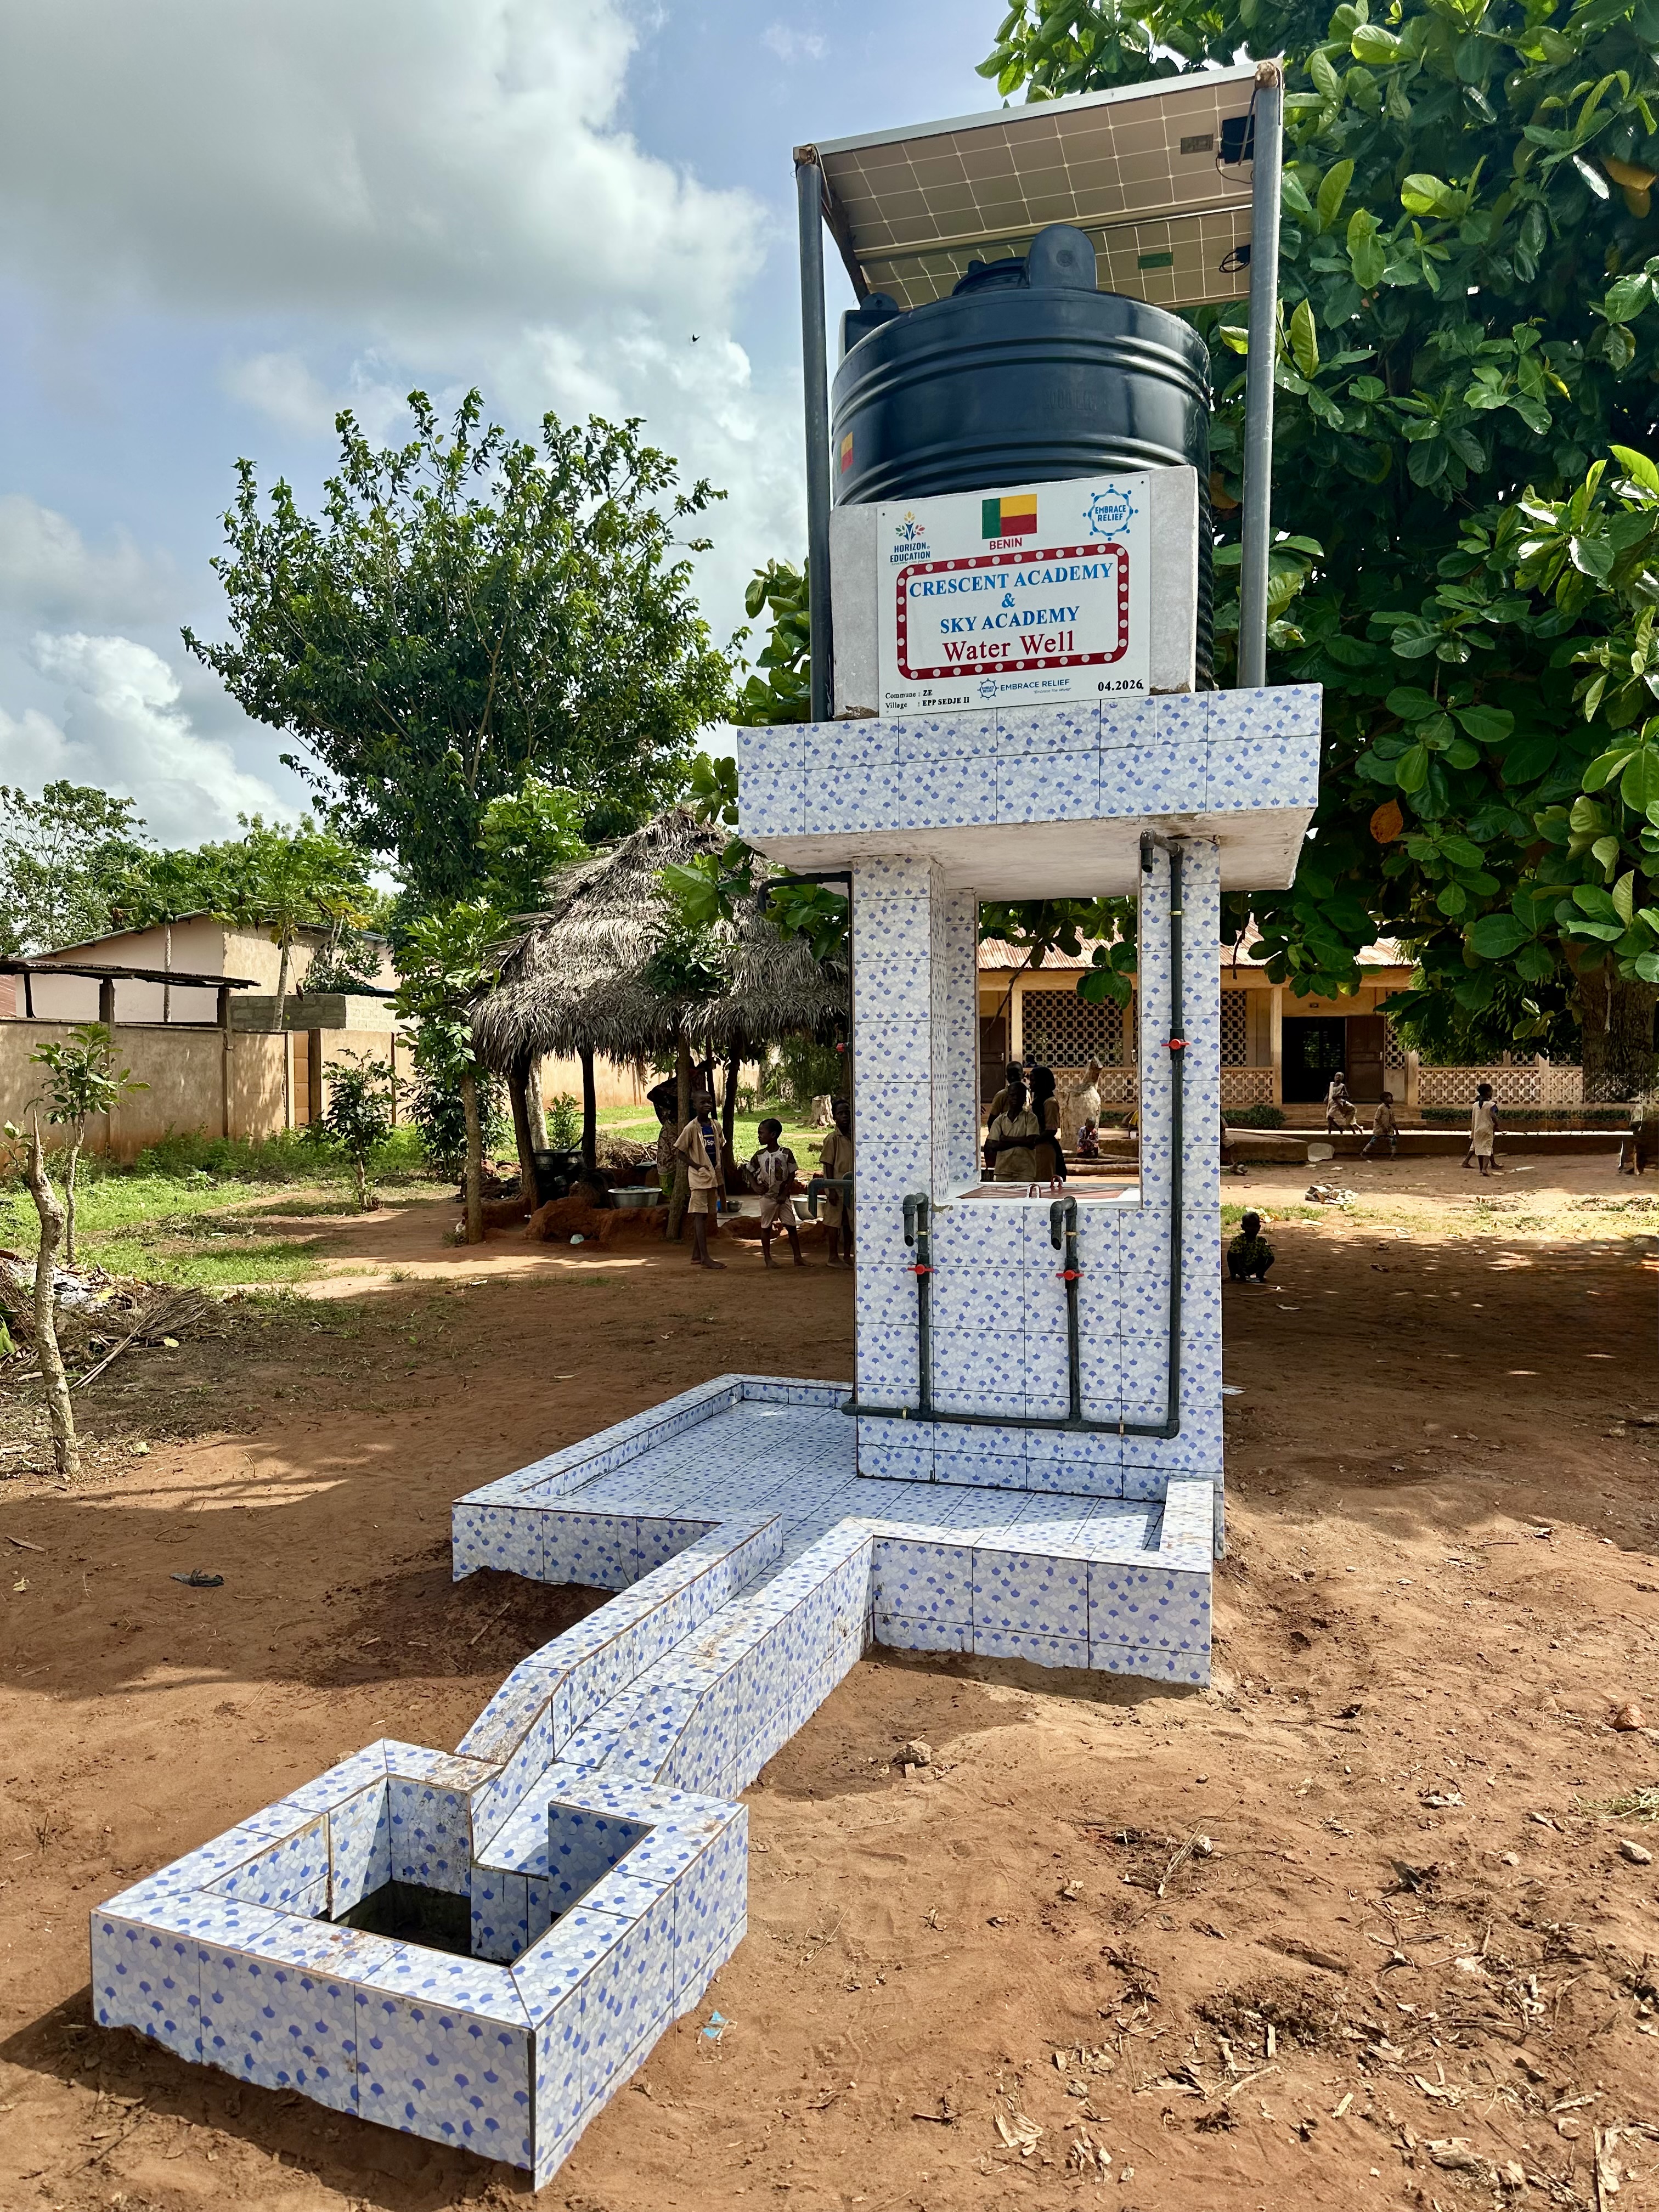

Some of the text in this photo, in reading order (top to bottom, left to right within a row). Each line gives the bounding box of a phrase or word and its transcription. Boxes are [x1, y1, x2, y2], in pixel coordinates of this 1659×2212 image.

[1094, 505, 1126, 514] EMBRACE
[1097, 513, 1124, 522] RELIEF
[894, 542, 926, 553] HORIZON
[989, 537, 1022, 550] BENIN
[890, 551, 930, 562] EDUCATION
[909, 562, 1113, 597] CRESCENT ACADEMY
[1001, 592, 1015, 608] &
[940, 606, 1080, 634] SKY ACADEMY
[941, 630, 1075, 663] Water Well
[1000, 679, 1070, 691] EMBRACE RELIEF
[1098, 679, 1143, 692] 04.2026
